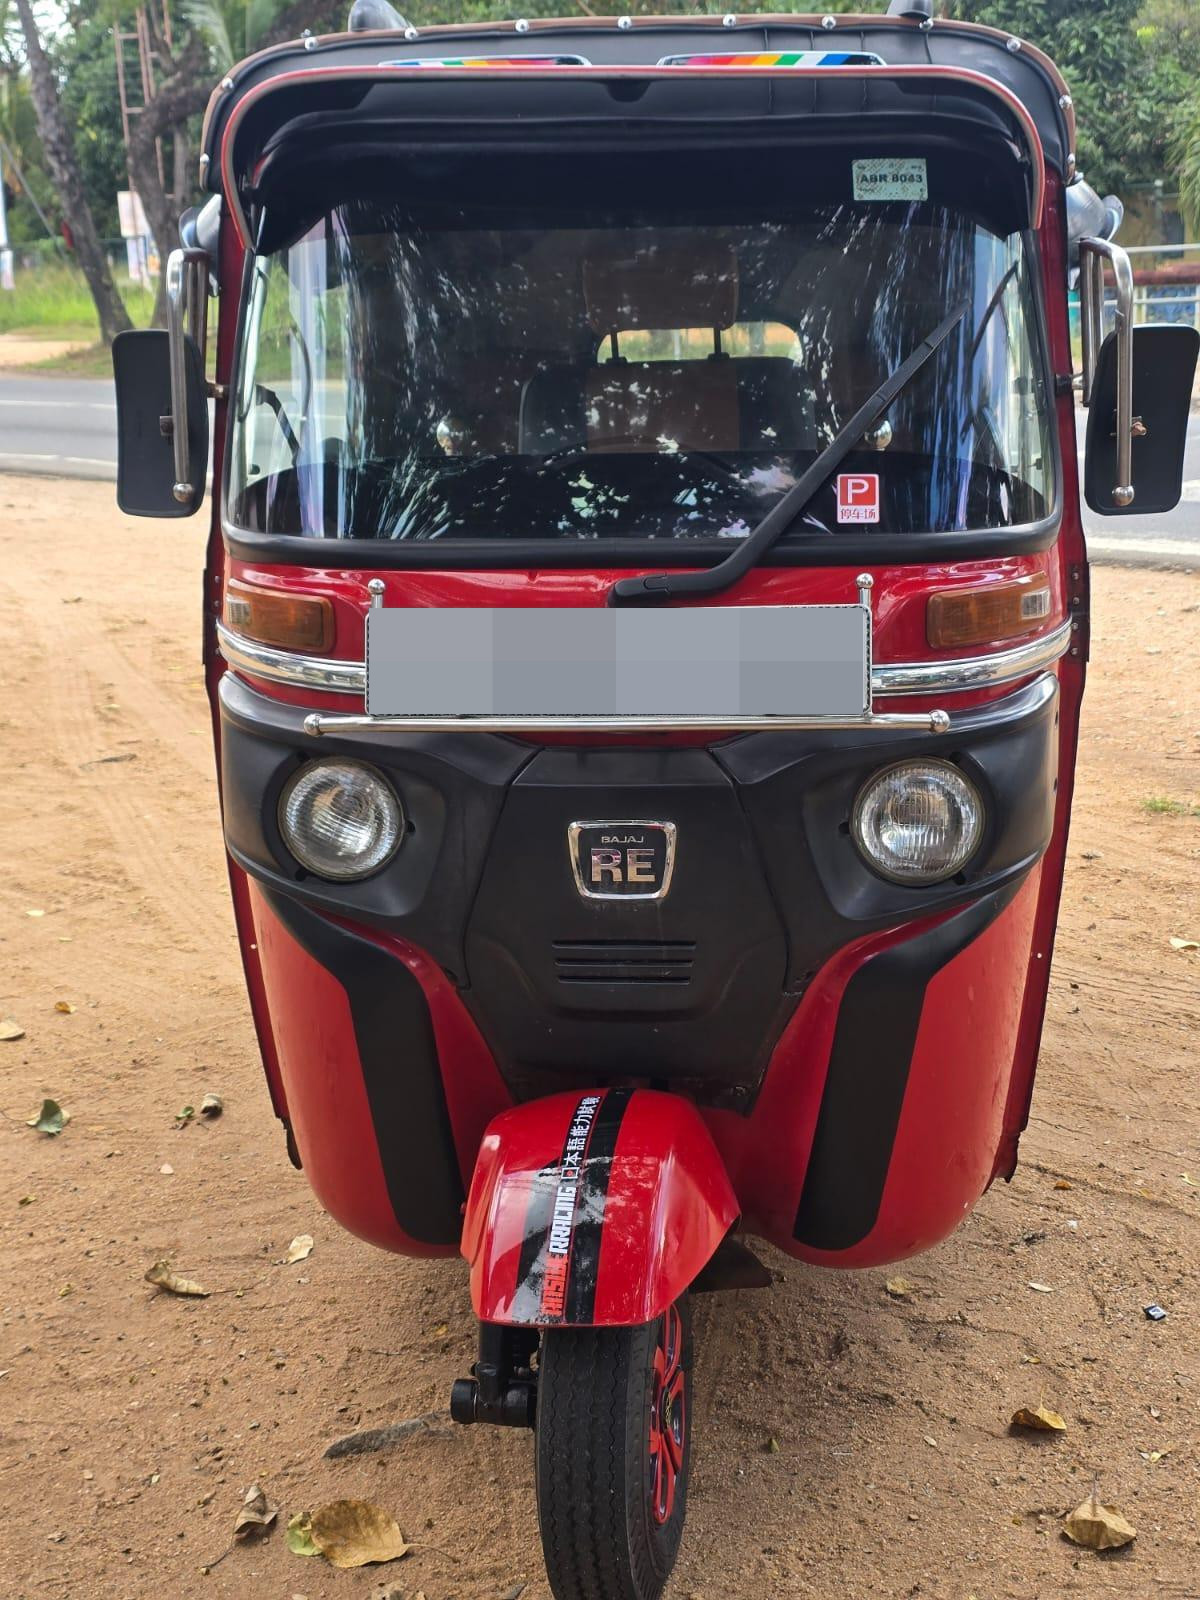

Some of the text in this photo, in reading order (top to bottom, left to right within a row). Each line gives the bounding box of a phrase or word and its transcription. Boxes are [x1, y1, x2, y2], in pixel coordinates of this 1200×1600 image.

[860, 174, 887, 183] ABR
[847, 478, 870, 504] P
[840, 508, 876, 520] 停车场
[601, 835, 644, 844] BAJAJ
[590, 848, 656, 882] RE
